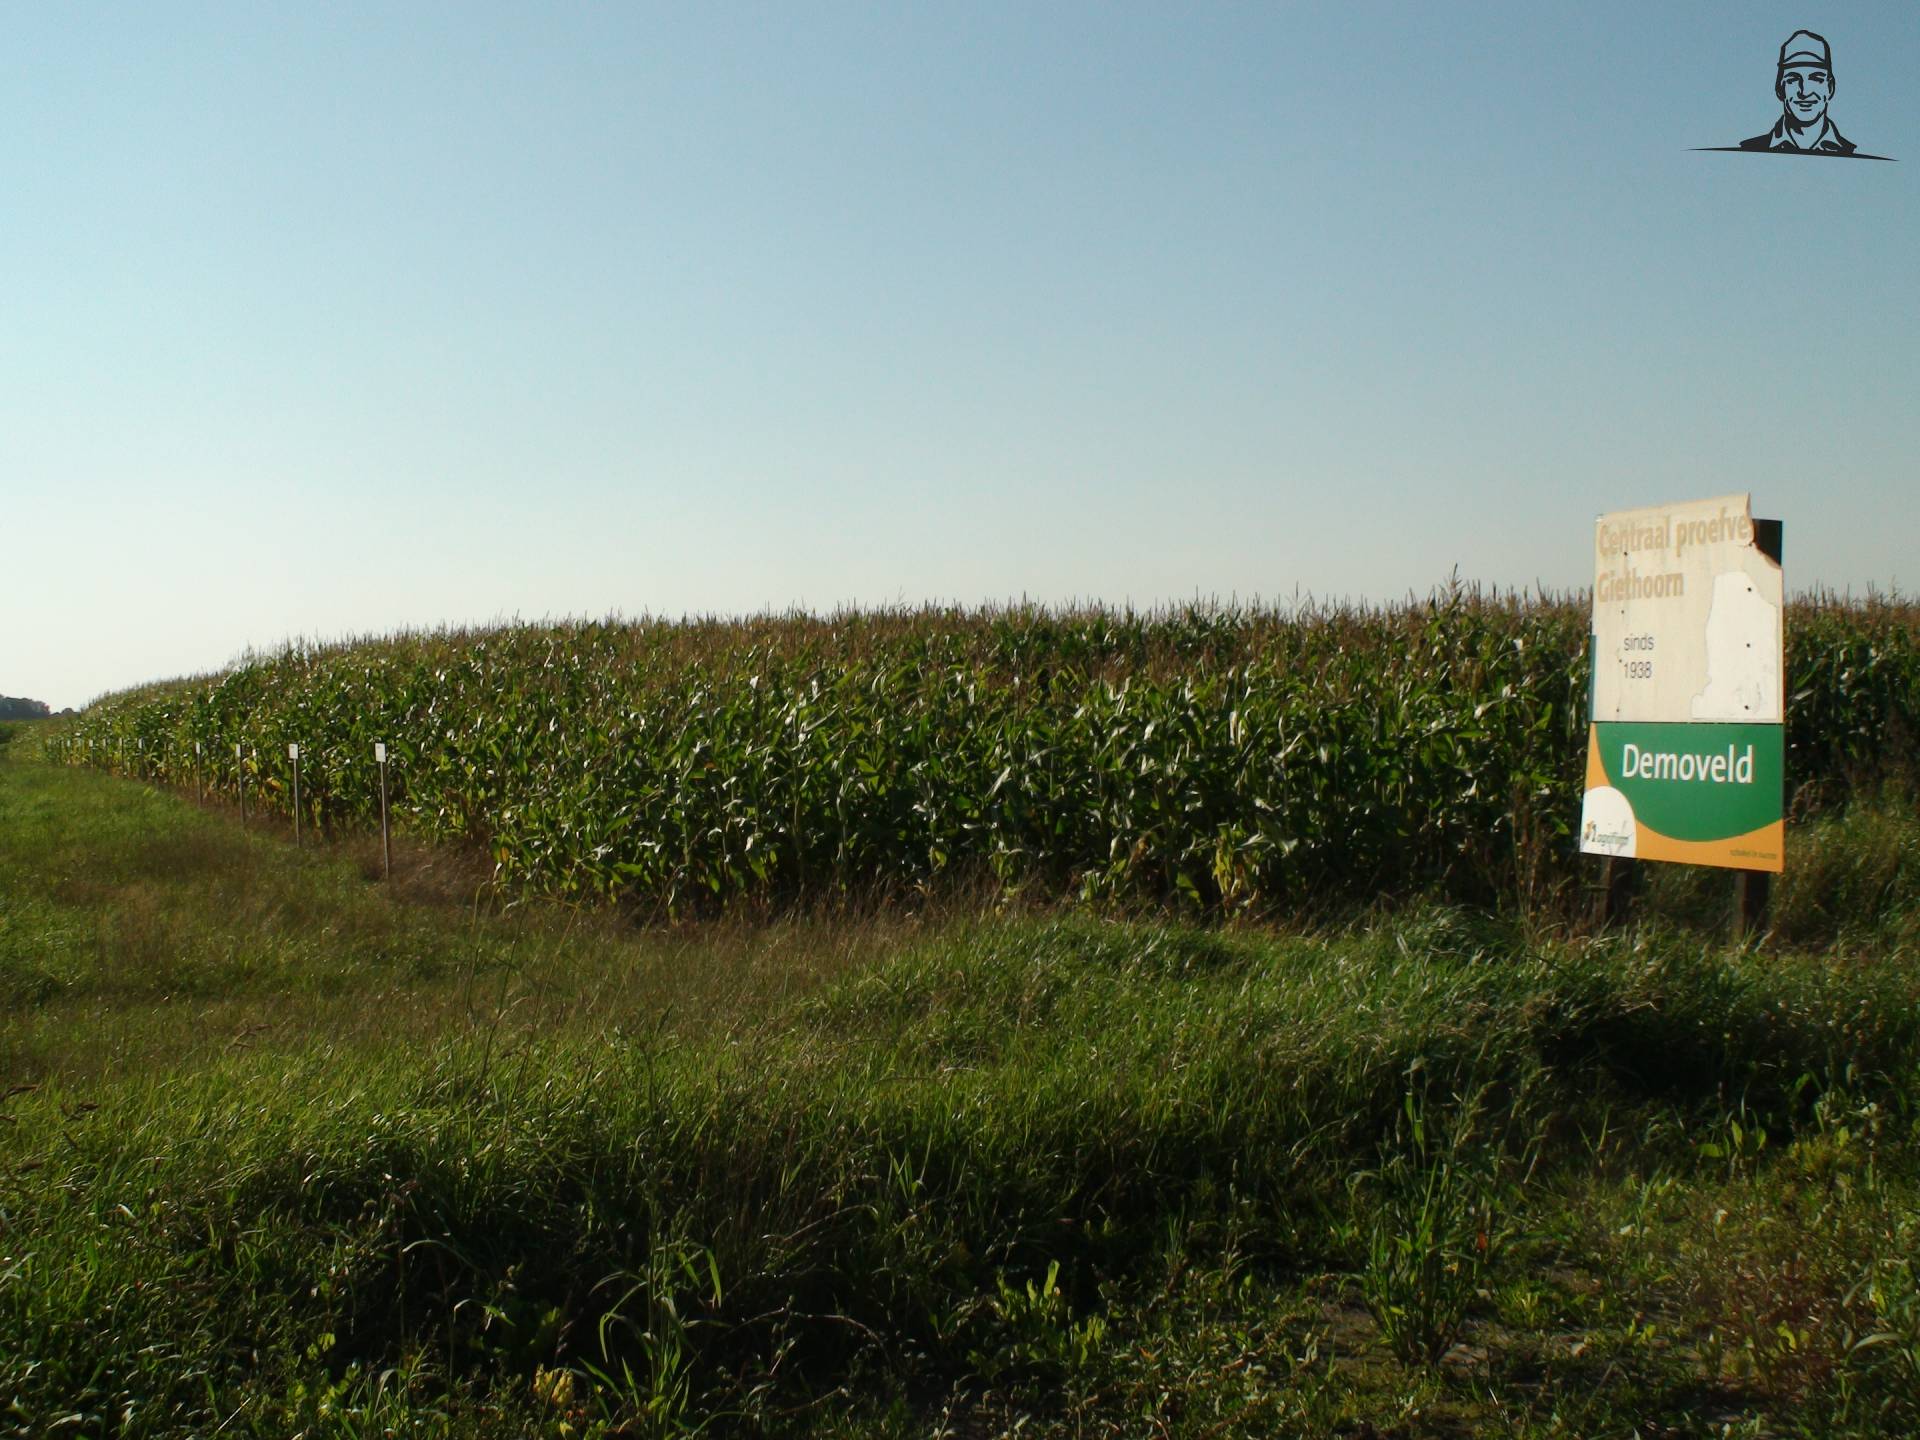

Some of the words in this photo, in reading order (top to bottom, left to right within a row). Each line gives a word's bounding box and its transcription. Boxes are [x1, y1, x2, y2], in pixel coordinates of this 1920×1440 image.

[1598, 517, 1670, 556] Centraal
[1597, 568, 1685, 602] Giethoorn
[1623, 634, 1655, 651] sinds
[1623, 661, 1653, 679] 1938
[1622, 744, 1754, 784] Demoveld
